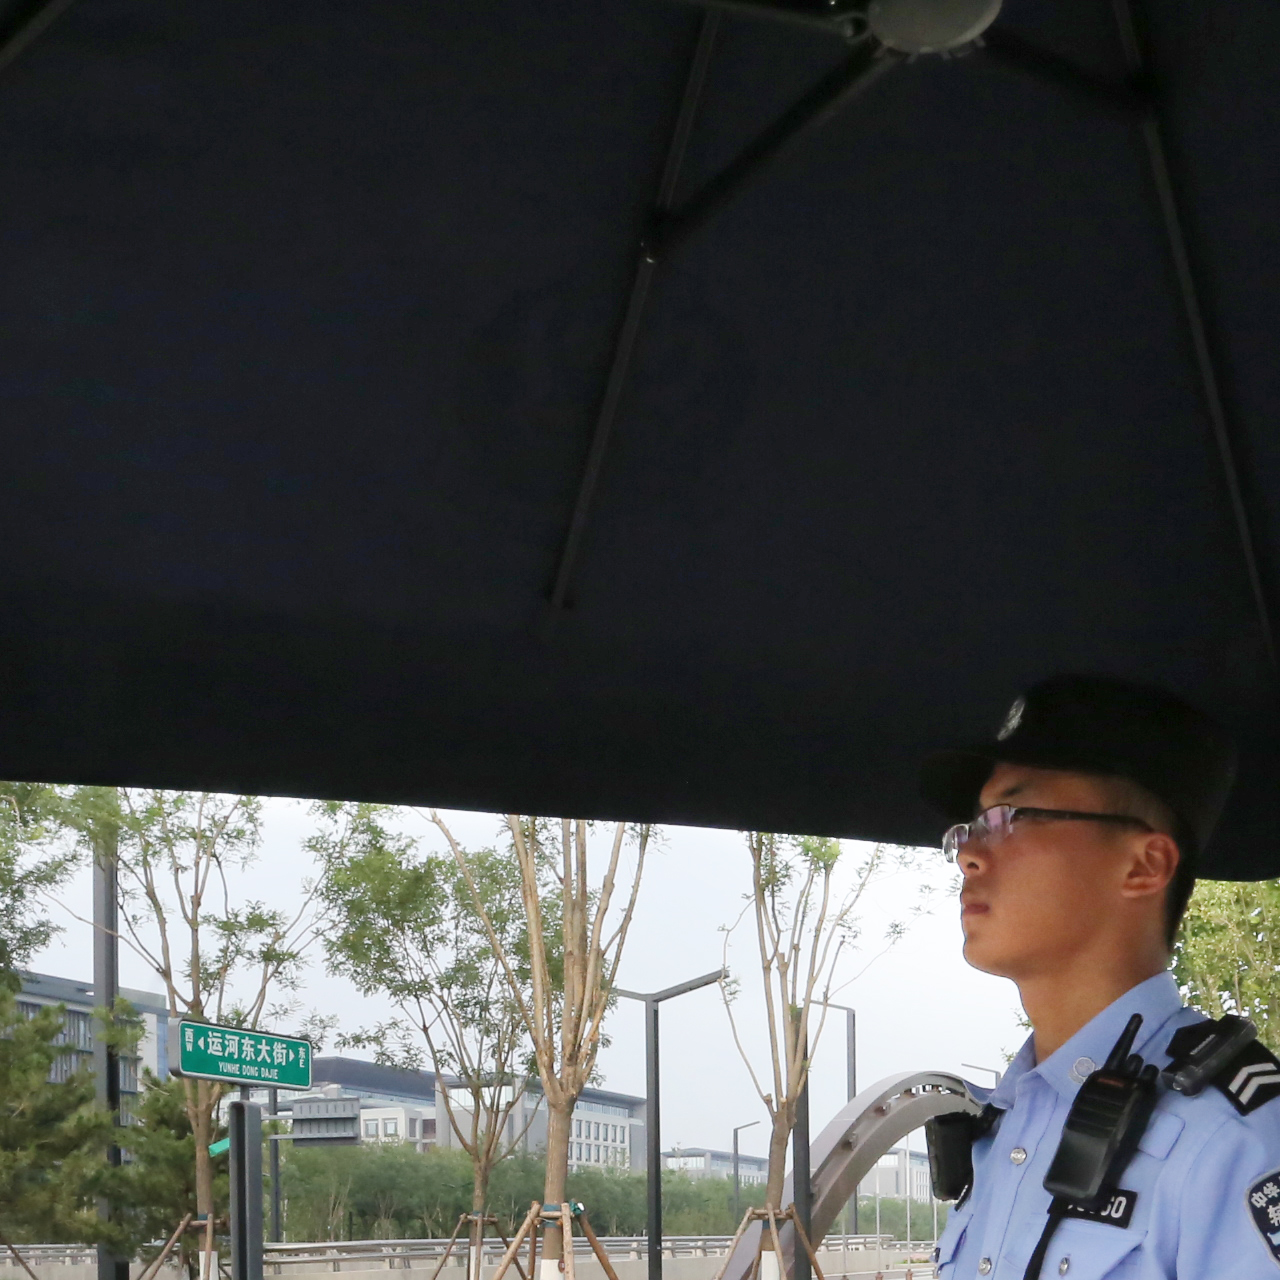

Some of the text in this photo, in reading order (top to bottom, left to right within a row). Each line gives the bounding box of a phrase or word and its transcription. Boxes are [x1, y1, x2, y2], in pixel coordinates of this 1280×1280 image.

[184, 1028, 194, 1042] 西
[186, 1042, 193, 1052] W
[207, 1031, 287, 1066] 运河东大街
[298, 1047, 306, 1059] 东
[299, 1059, 305, 1068] E
[218, 1062, 278, 1079] YUNHE DONG DAJIE
